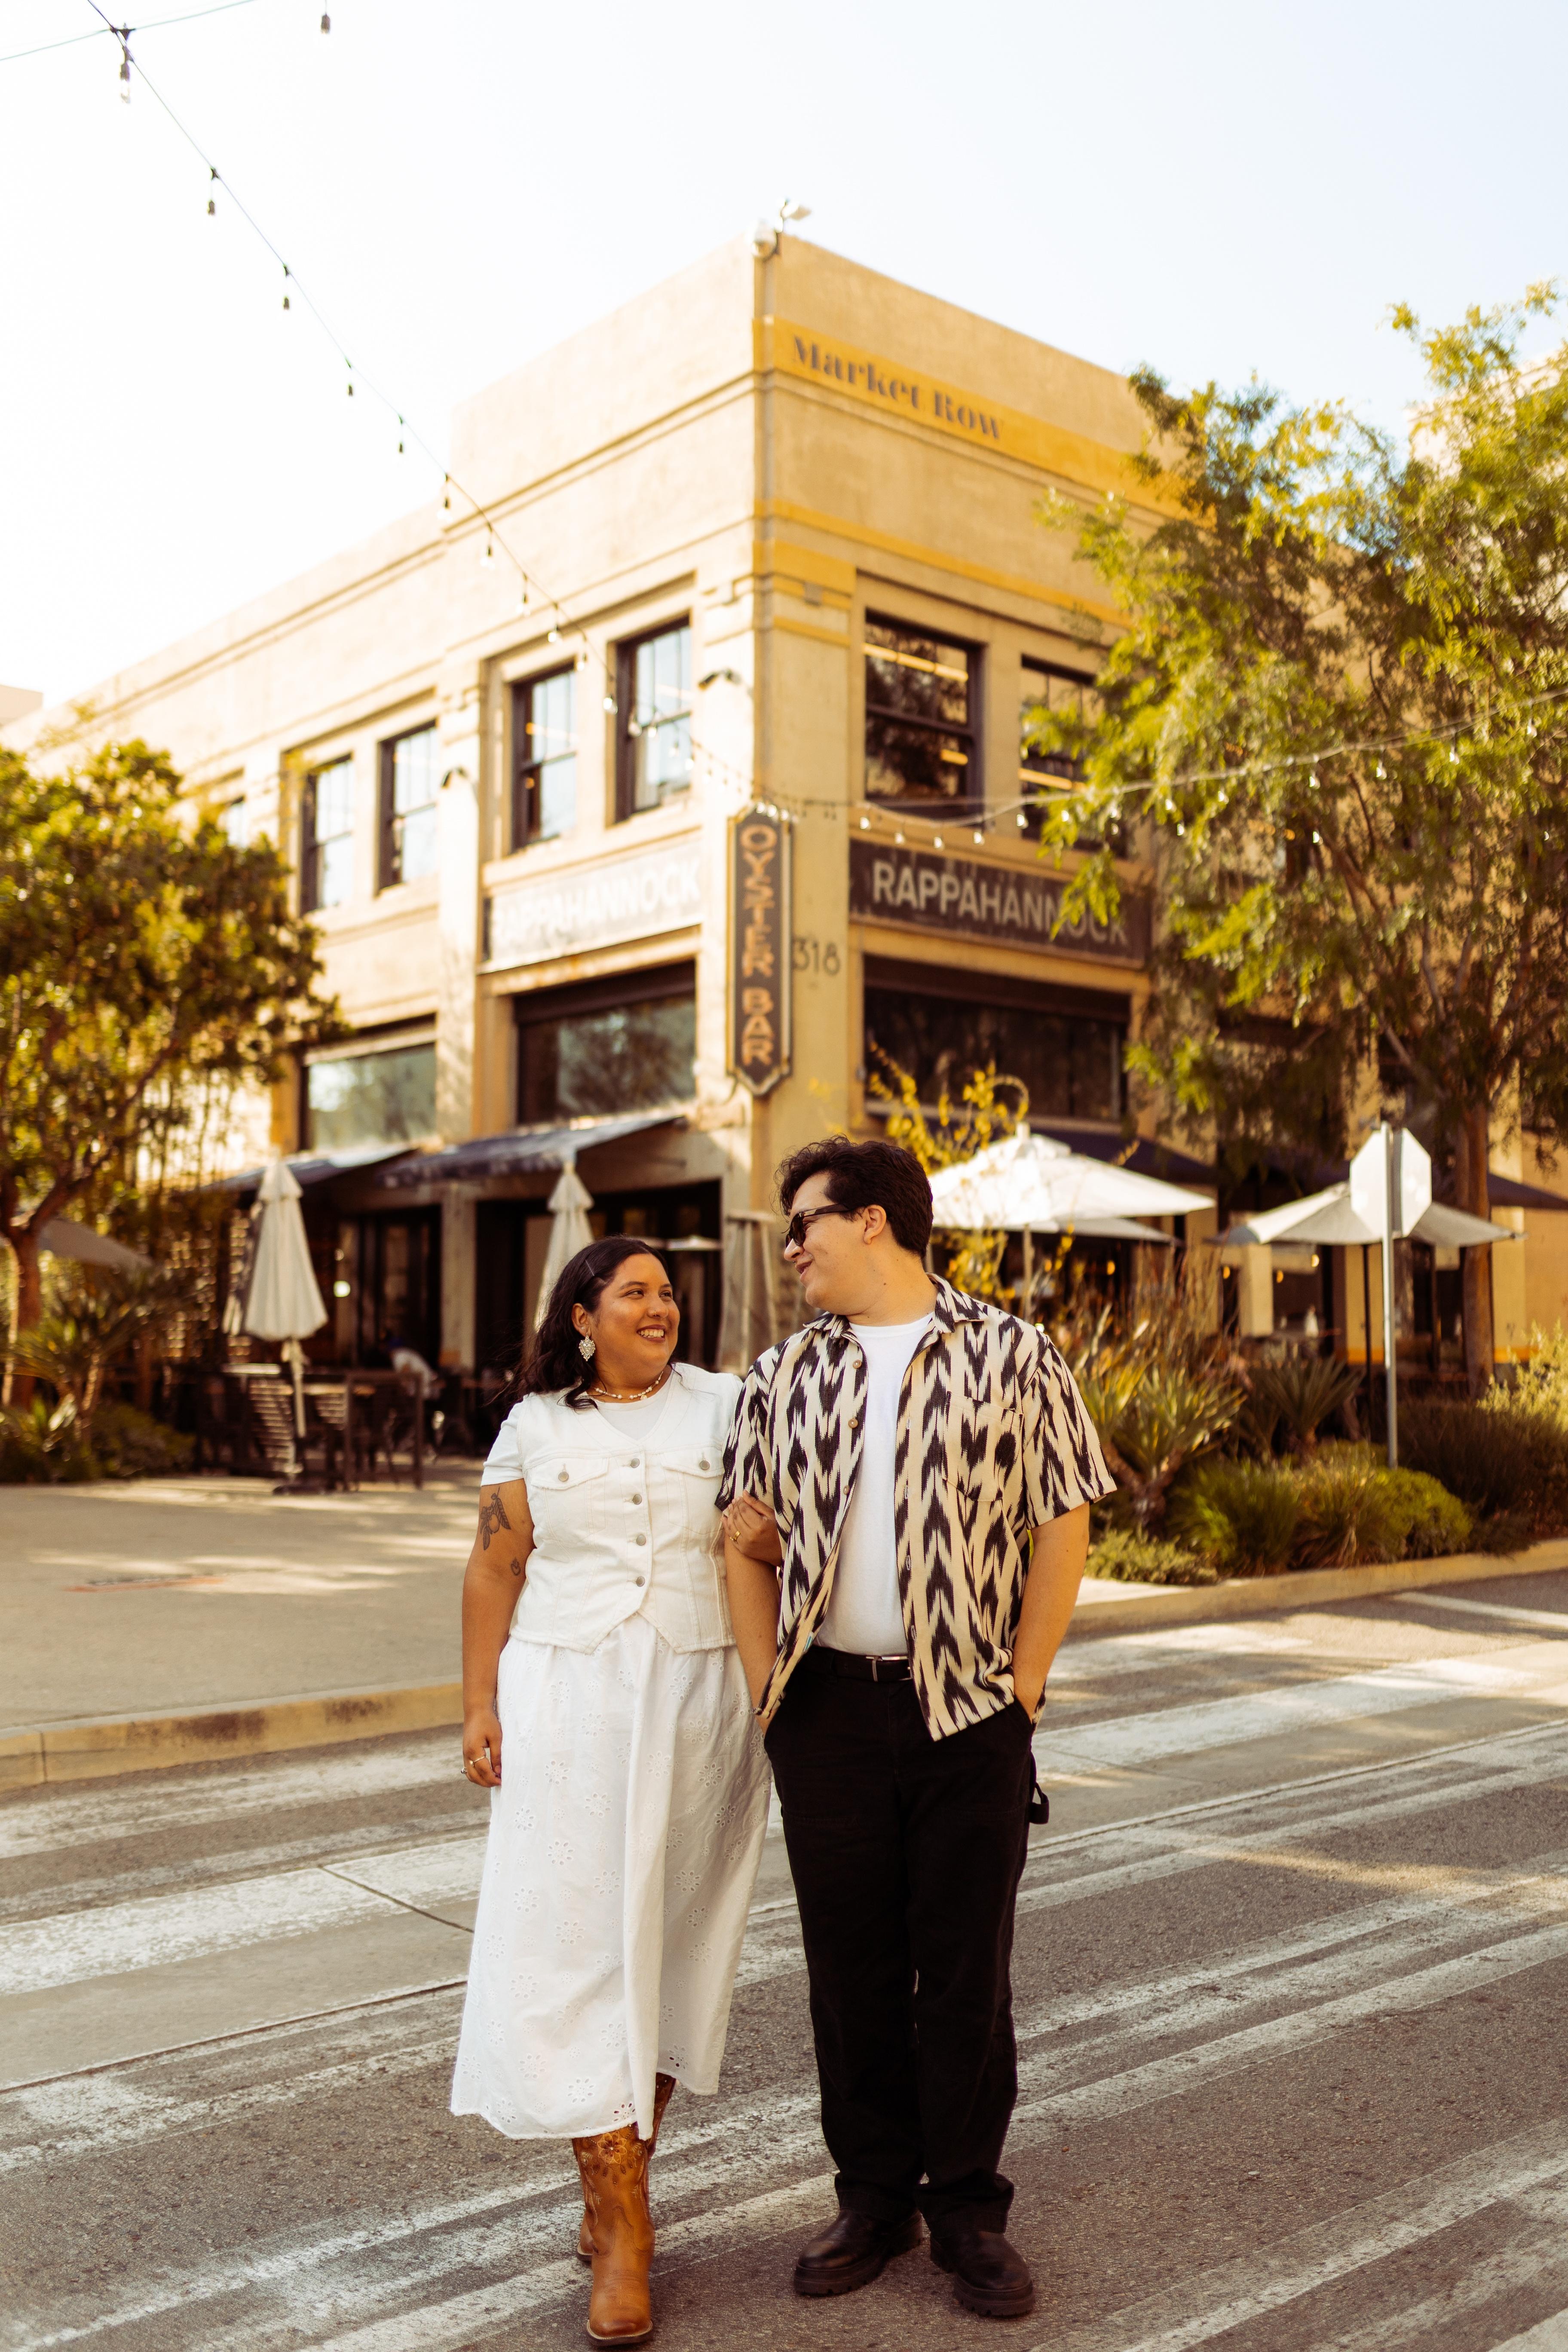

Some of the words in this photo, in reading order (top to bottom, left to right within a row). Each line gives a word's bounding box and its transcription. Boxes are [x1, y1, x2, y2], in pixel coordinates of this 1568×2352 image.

[793, 335, 922, 409] Market
[934, 392, 1003, 439] Row
[741, 824, 778, 977] OYSTER
[792, 937, 841, 976] 318
[742, 987, 774, 1065] BAR
